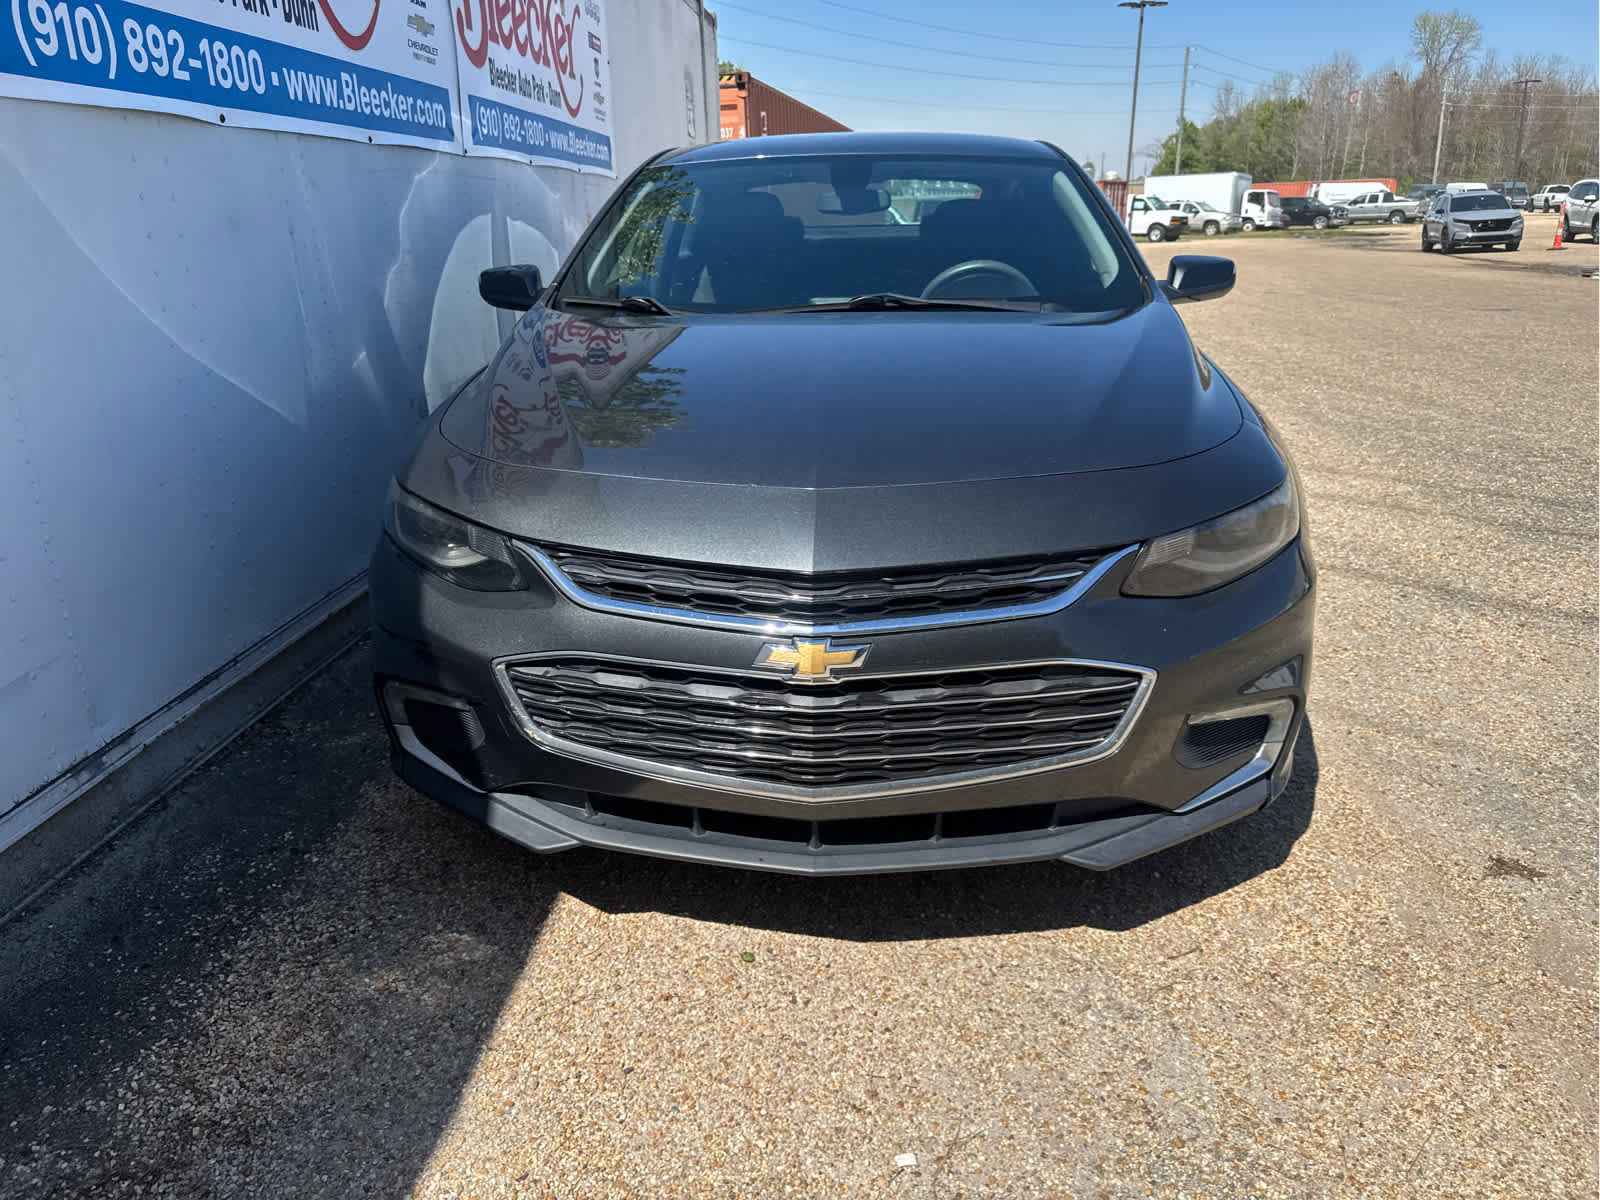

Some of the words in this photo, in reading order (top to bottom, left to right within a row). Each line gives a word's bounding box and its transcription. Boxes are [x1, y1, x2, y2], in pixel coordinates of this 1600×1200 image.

[11, 0, 117, 80] (910)
[123, 18, 267, 95] 892-1800
[282, 67, 447, 129] www.Bleecker.com
[488, 57, 518, 94] Bleecker
[475, 102, 503, 145] (910)
[503, 112, 546, 147] 892-1800
[549, 130, 610, 163] www.Bleecker.com
